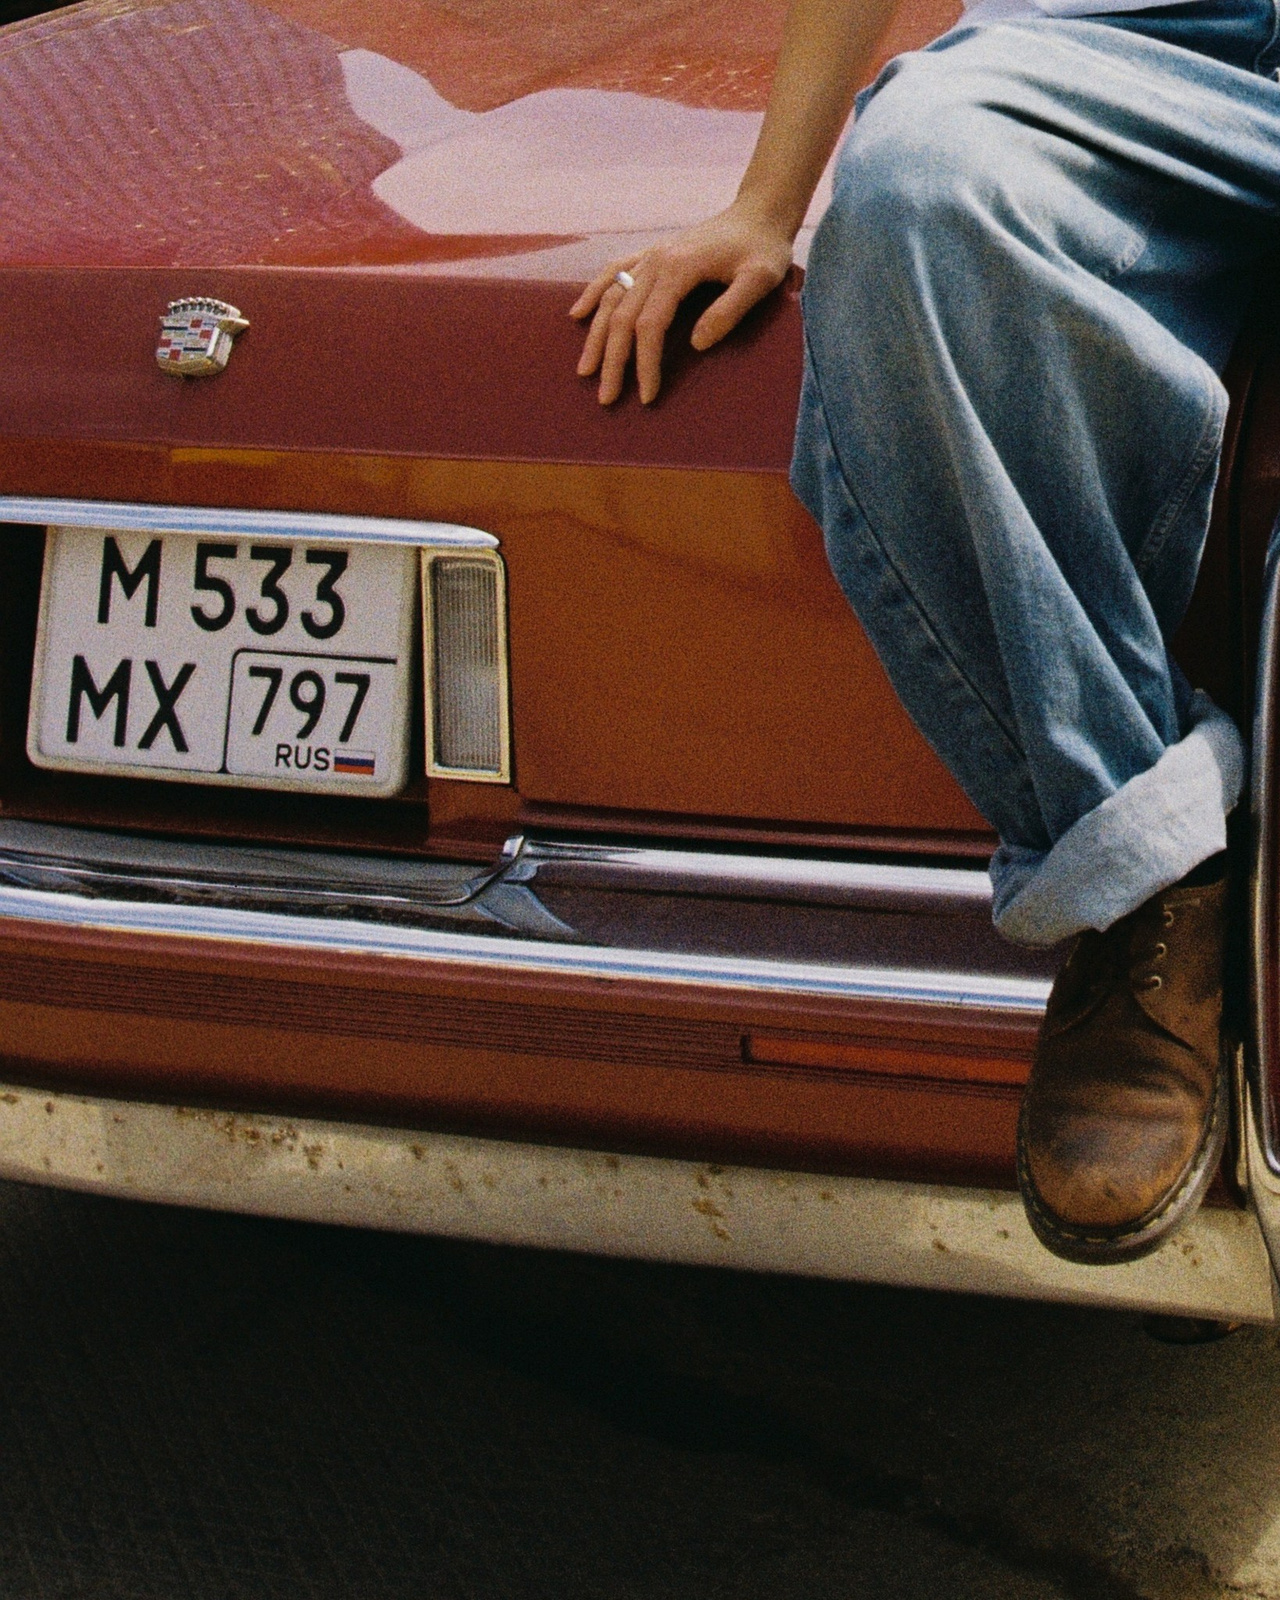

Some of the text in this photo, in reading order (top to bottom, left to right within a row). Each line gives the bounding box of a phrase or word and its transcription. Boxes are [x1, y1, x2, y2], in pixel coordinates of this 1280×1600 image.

[190, 542, 350, 639] 533
[66, 655, 196, 753] MX
[248, 665, 371, 744] 797
[274, 743, 330, 772] RUS
